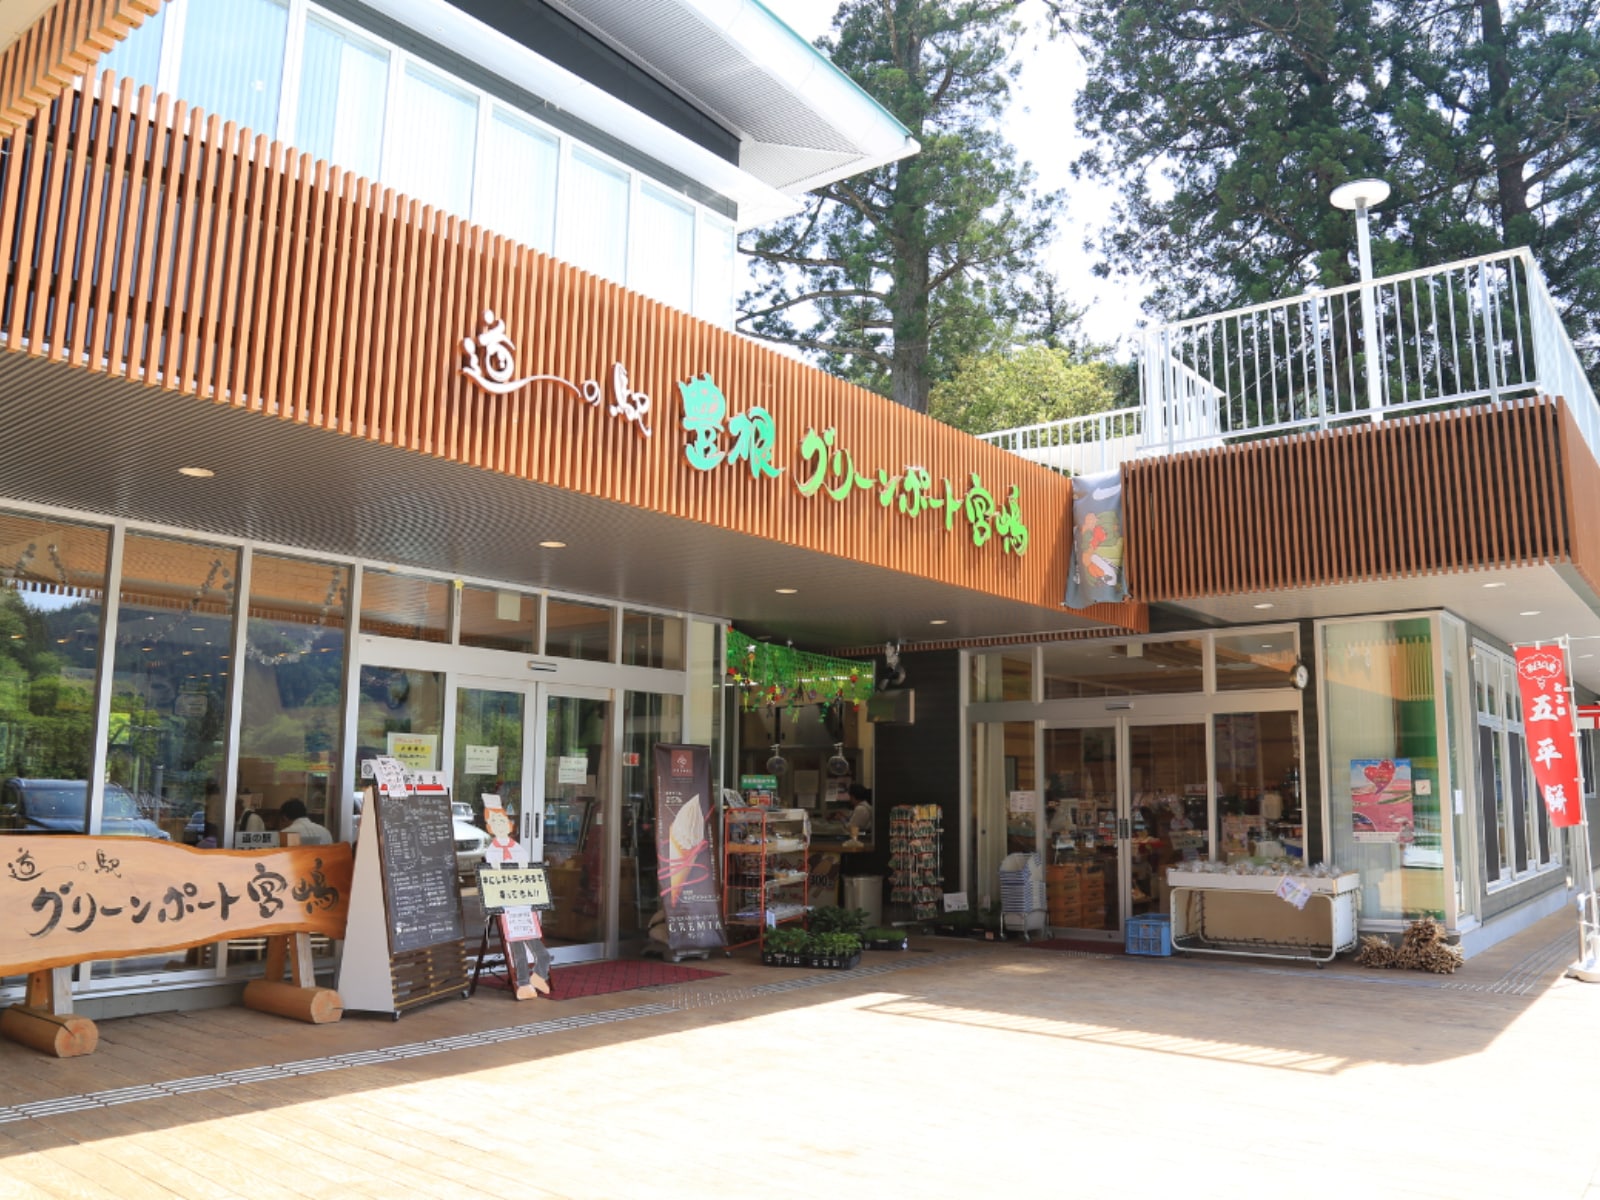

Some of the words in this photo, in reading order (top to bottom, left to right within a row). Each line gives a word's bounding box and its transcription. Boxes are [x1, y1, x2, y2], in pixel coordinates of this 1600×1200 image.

[461, 310, 652, 438] 道の駅
[8, 847, 122, 882] 道の駅
[242, 833, 272, 844] 道の駅
[24, 858, 340, 938] グリーンポート宮嶋
